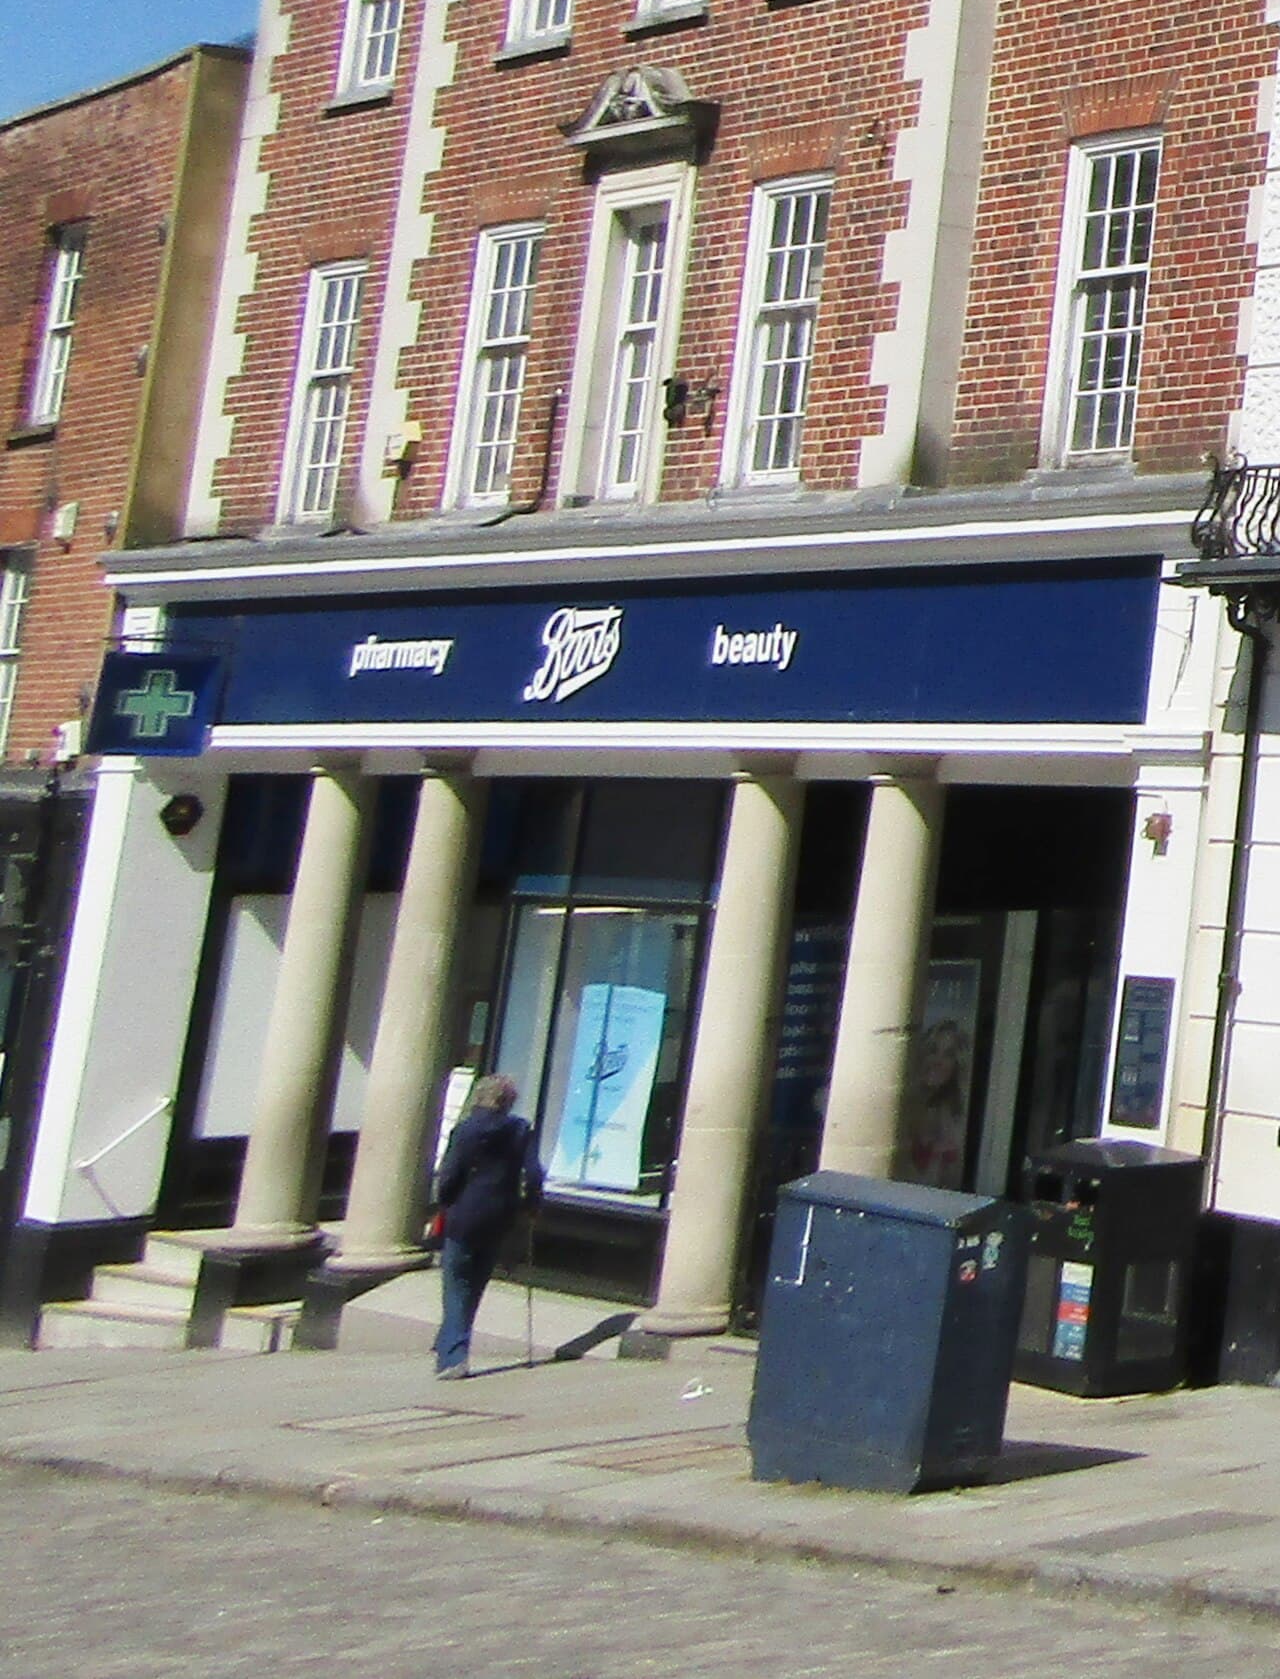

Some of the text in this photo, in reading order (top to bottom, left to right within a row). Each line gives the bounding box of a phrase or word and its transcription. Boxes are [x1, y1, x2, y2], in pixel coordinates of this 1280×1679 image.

[349, 634, 455, 679] pharmacy
[523, 605, 624, 703] Boots
[711, 623, 797, 671] beauty
